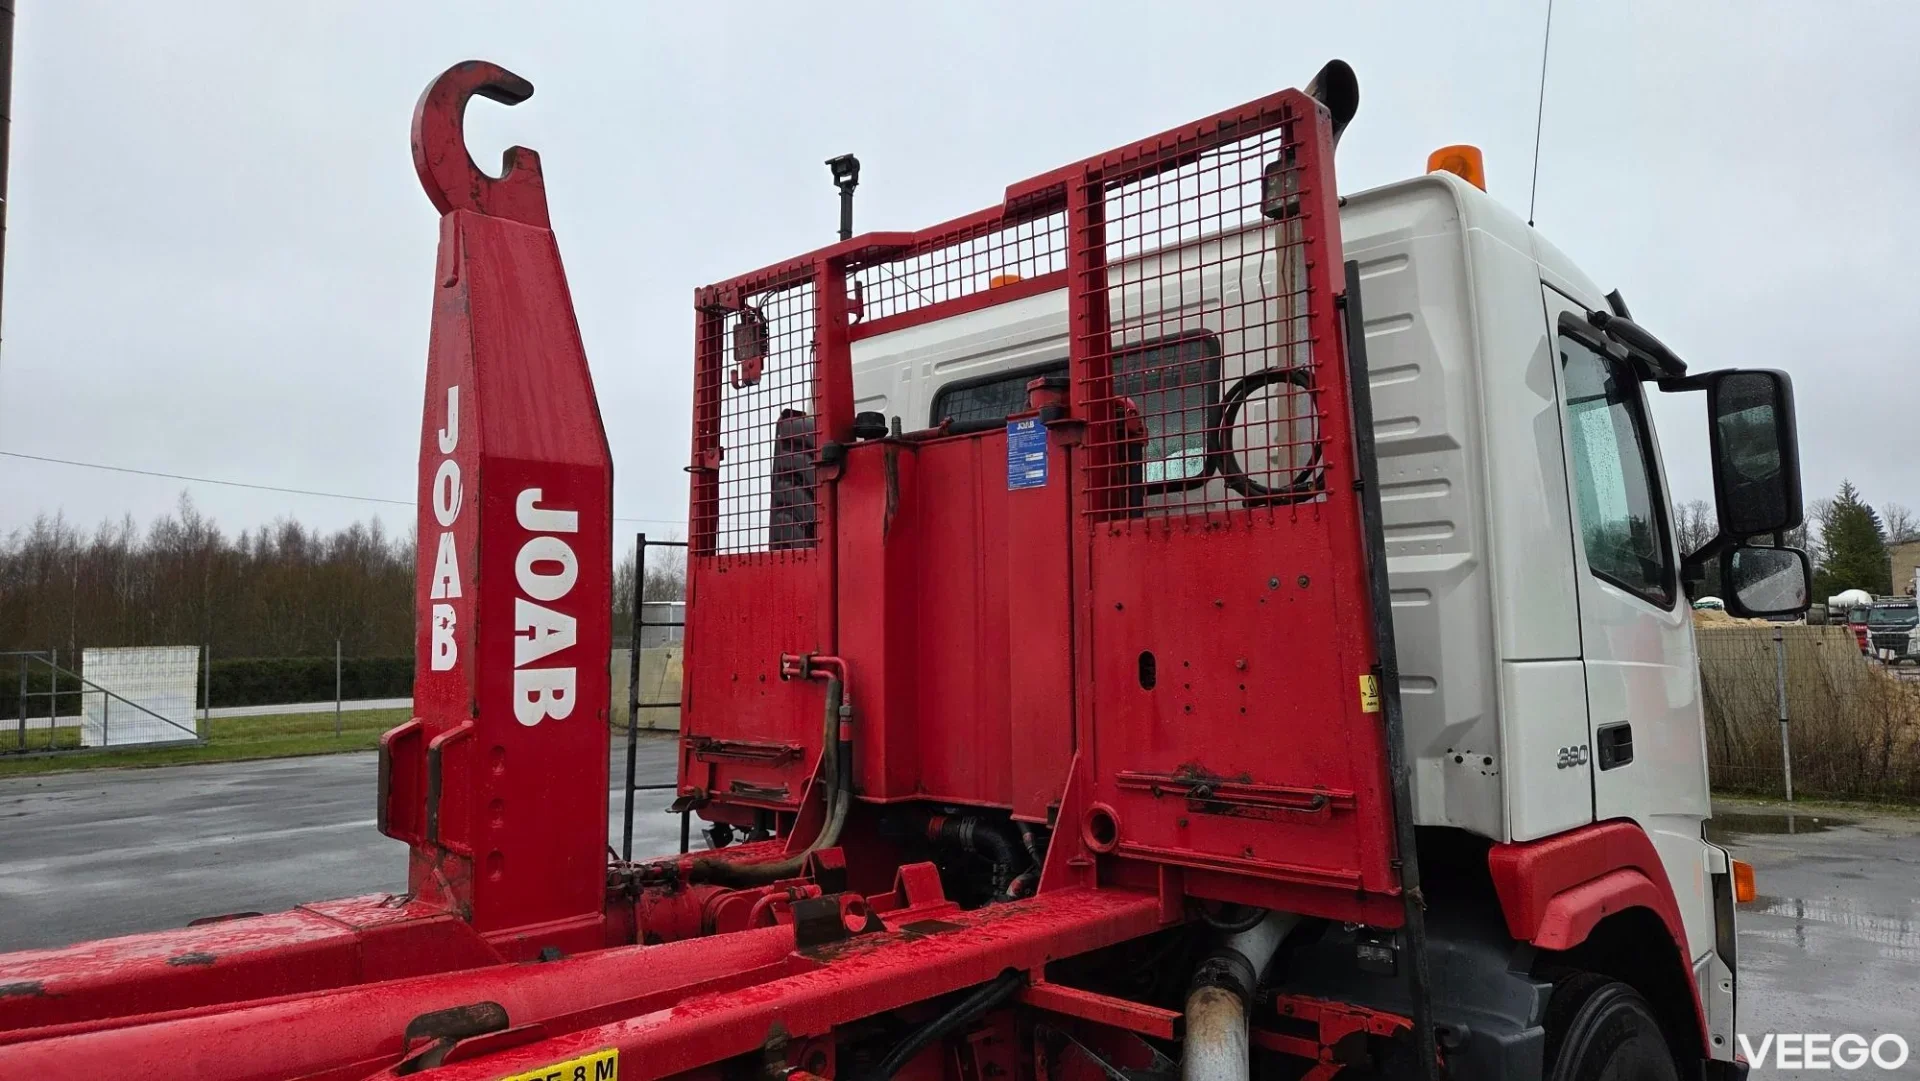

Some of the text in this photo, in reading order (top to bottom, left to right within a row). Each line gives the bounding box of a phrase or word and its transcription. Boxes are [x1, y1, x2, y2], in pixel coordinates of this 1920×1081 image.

[430, 385, 463, 671] JOAB
[513, 488, 579, 727] JOAB
[1557, 744, 1588, 769] 380
